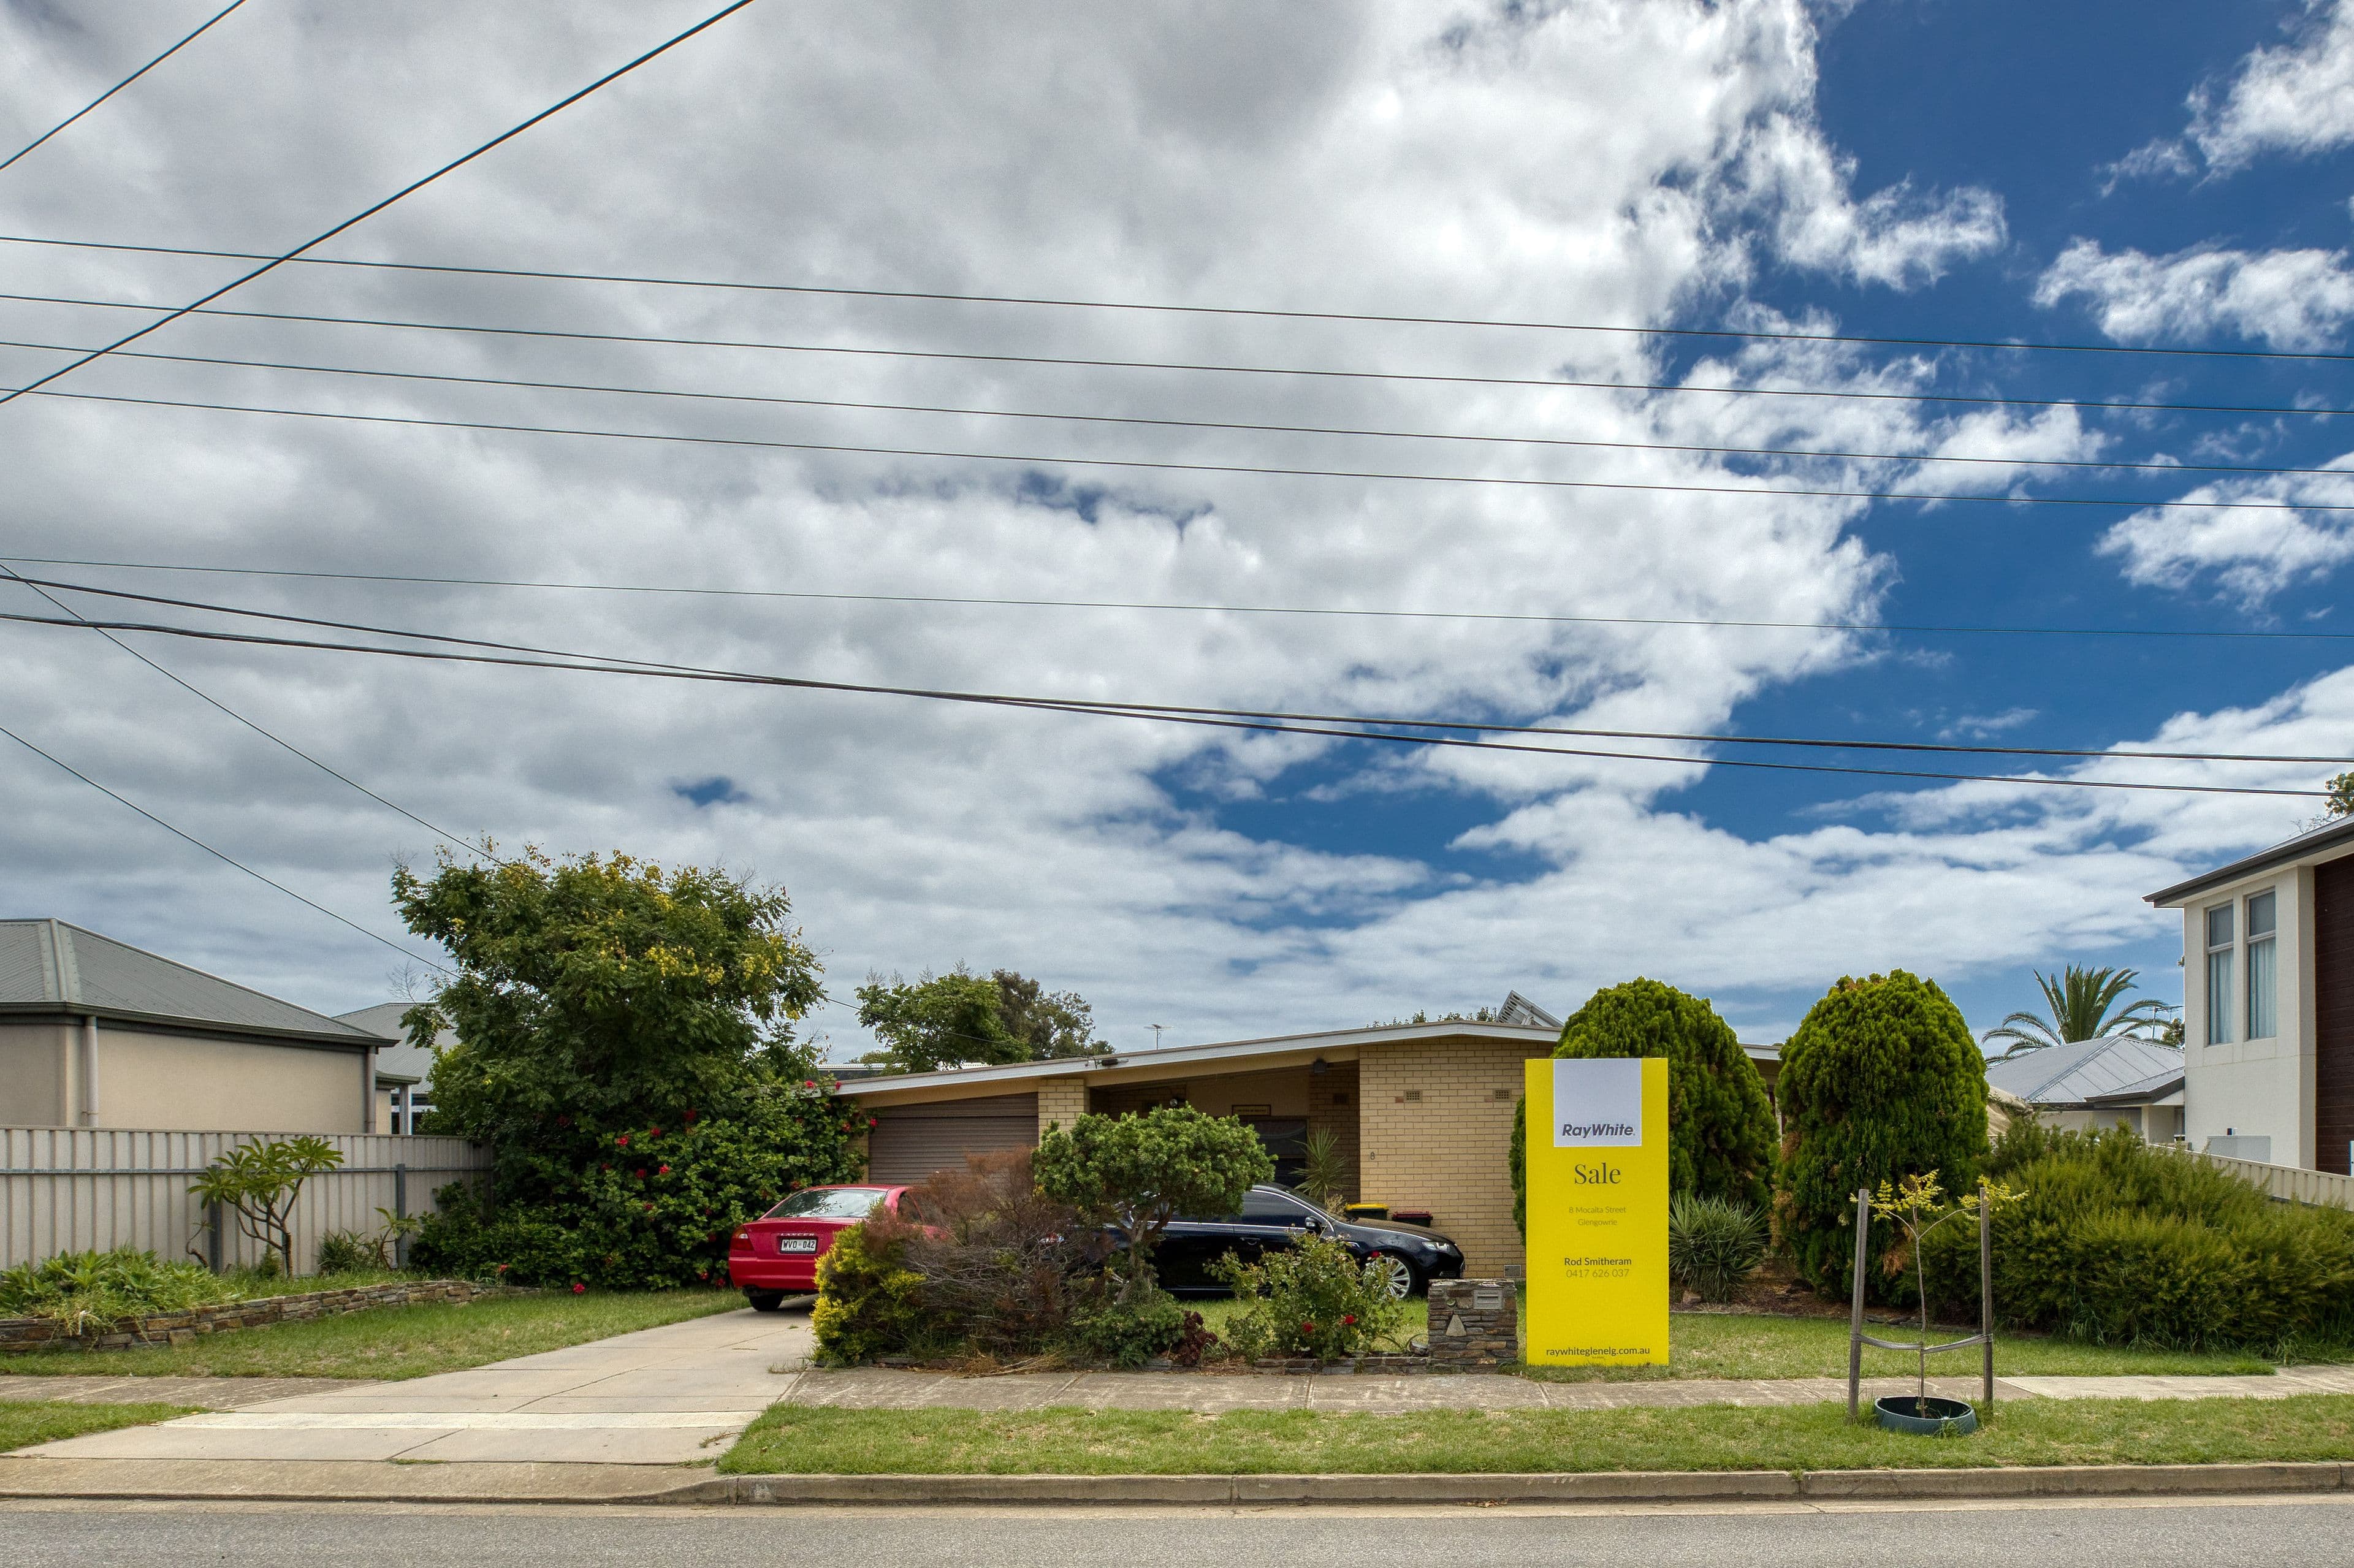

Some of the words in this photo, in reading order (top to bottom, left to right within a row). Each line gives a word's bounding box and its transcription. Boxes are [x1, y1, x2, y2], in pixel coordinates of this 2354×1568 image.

[1574, 1162, 1621, 1184] Sale
[802, 1240, 815, 1249] 042
[1564, 1257, 1582, 1266] Rod
[1584, 1257, 1632, 1266] Smitheram
[1566, 1269, 1590, 1278] 0417
[1592, 1269, 1609, 1277] 626
[1612, 1268, 1629, 1277] 037
[1546, 1347, 1650, 1357] raywhiteglenelg.com.au
